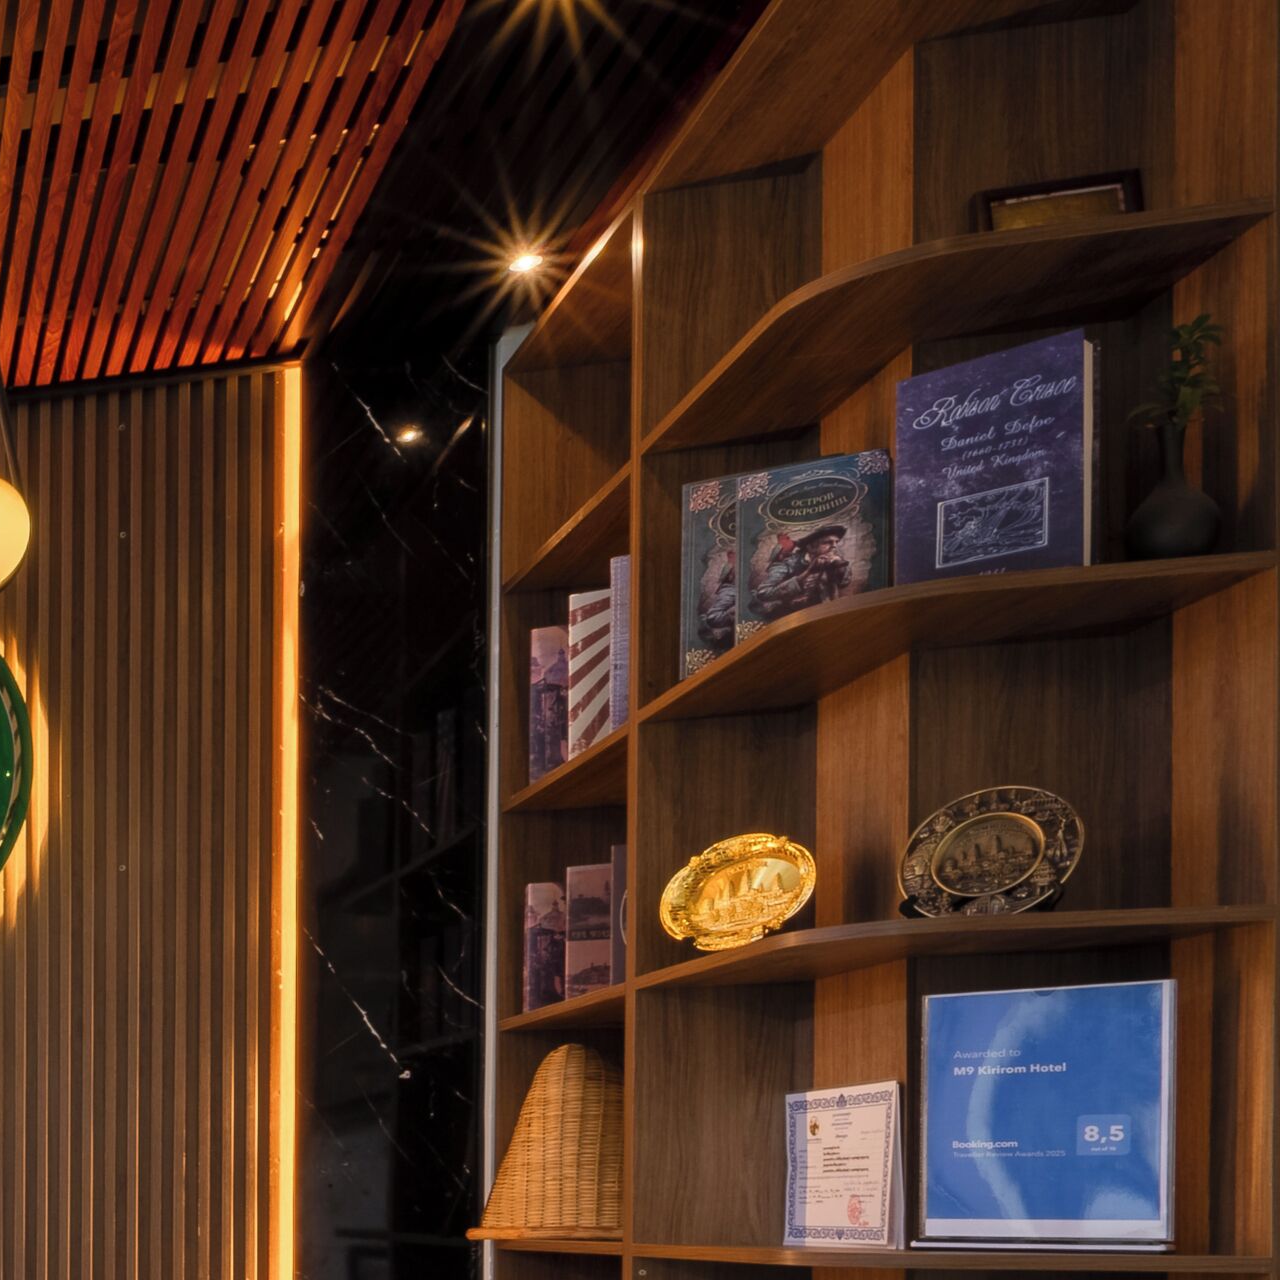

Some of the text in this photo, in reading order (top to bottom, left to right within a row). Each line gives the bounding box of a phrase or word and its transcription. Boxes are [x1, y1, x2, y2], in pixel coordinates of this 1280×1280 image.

[953, 1048, 1021, 1059] Awarded to
[953, 1062, 1067, 1076] M9 Kirirom Hotel
[1084, 1125, 1124, 1143] 8,5
[952, 1139, 1018, 1150] Booking.com
